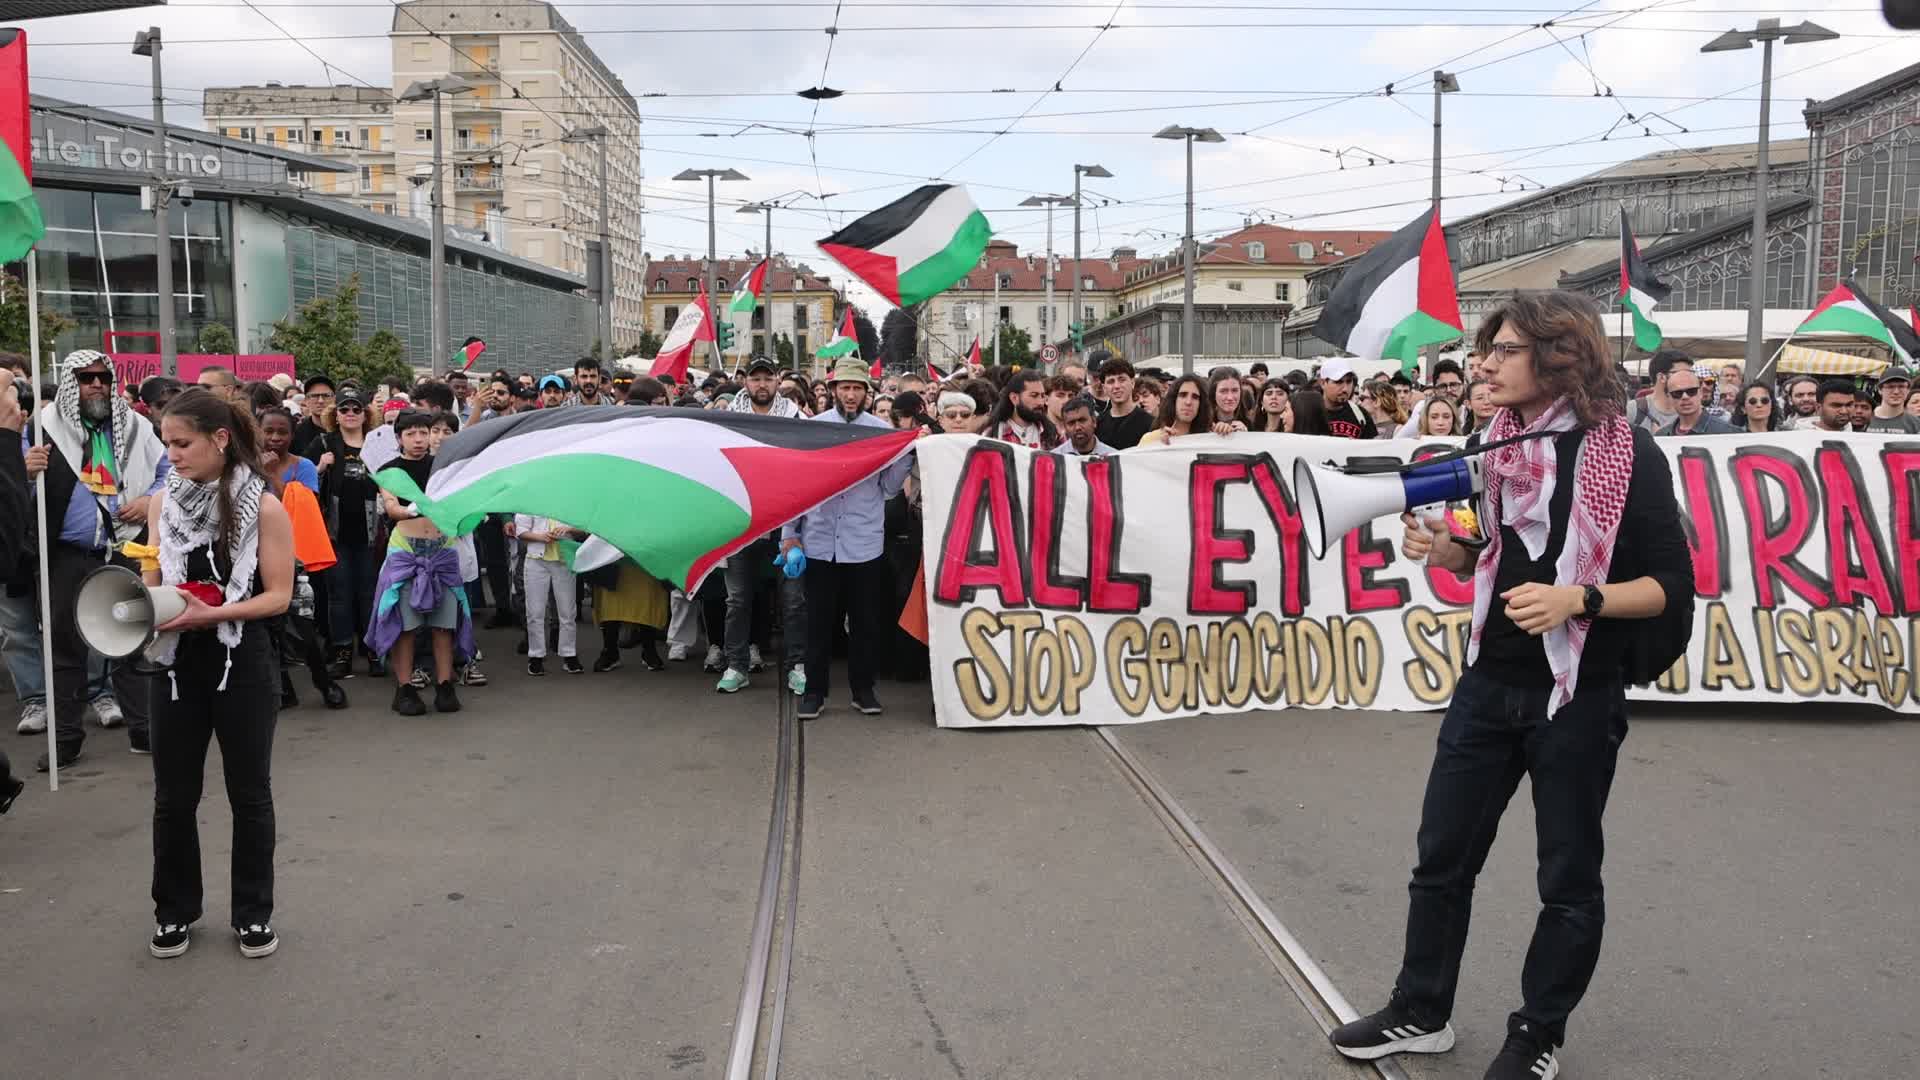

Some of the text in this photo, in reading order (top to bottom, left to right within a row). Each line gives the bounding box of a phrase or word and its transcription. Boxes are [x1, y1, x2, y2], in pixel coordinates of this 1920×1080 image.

[96, 135, 221, 174] Torino
[1044, 349, 1055, 359] 30
[933, 439, 1151, 614] ALL
[954, 606, 1097, 721] STOP
[1701, 601, 1755, 692] A
